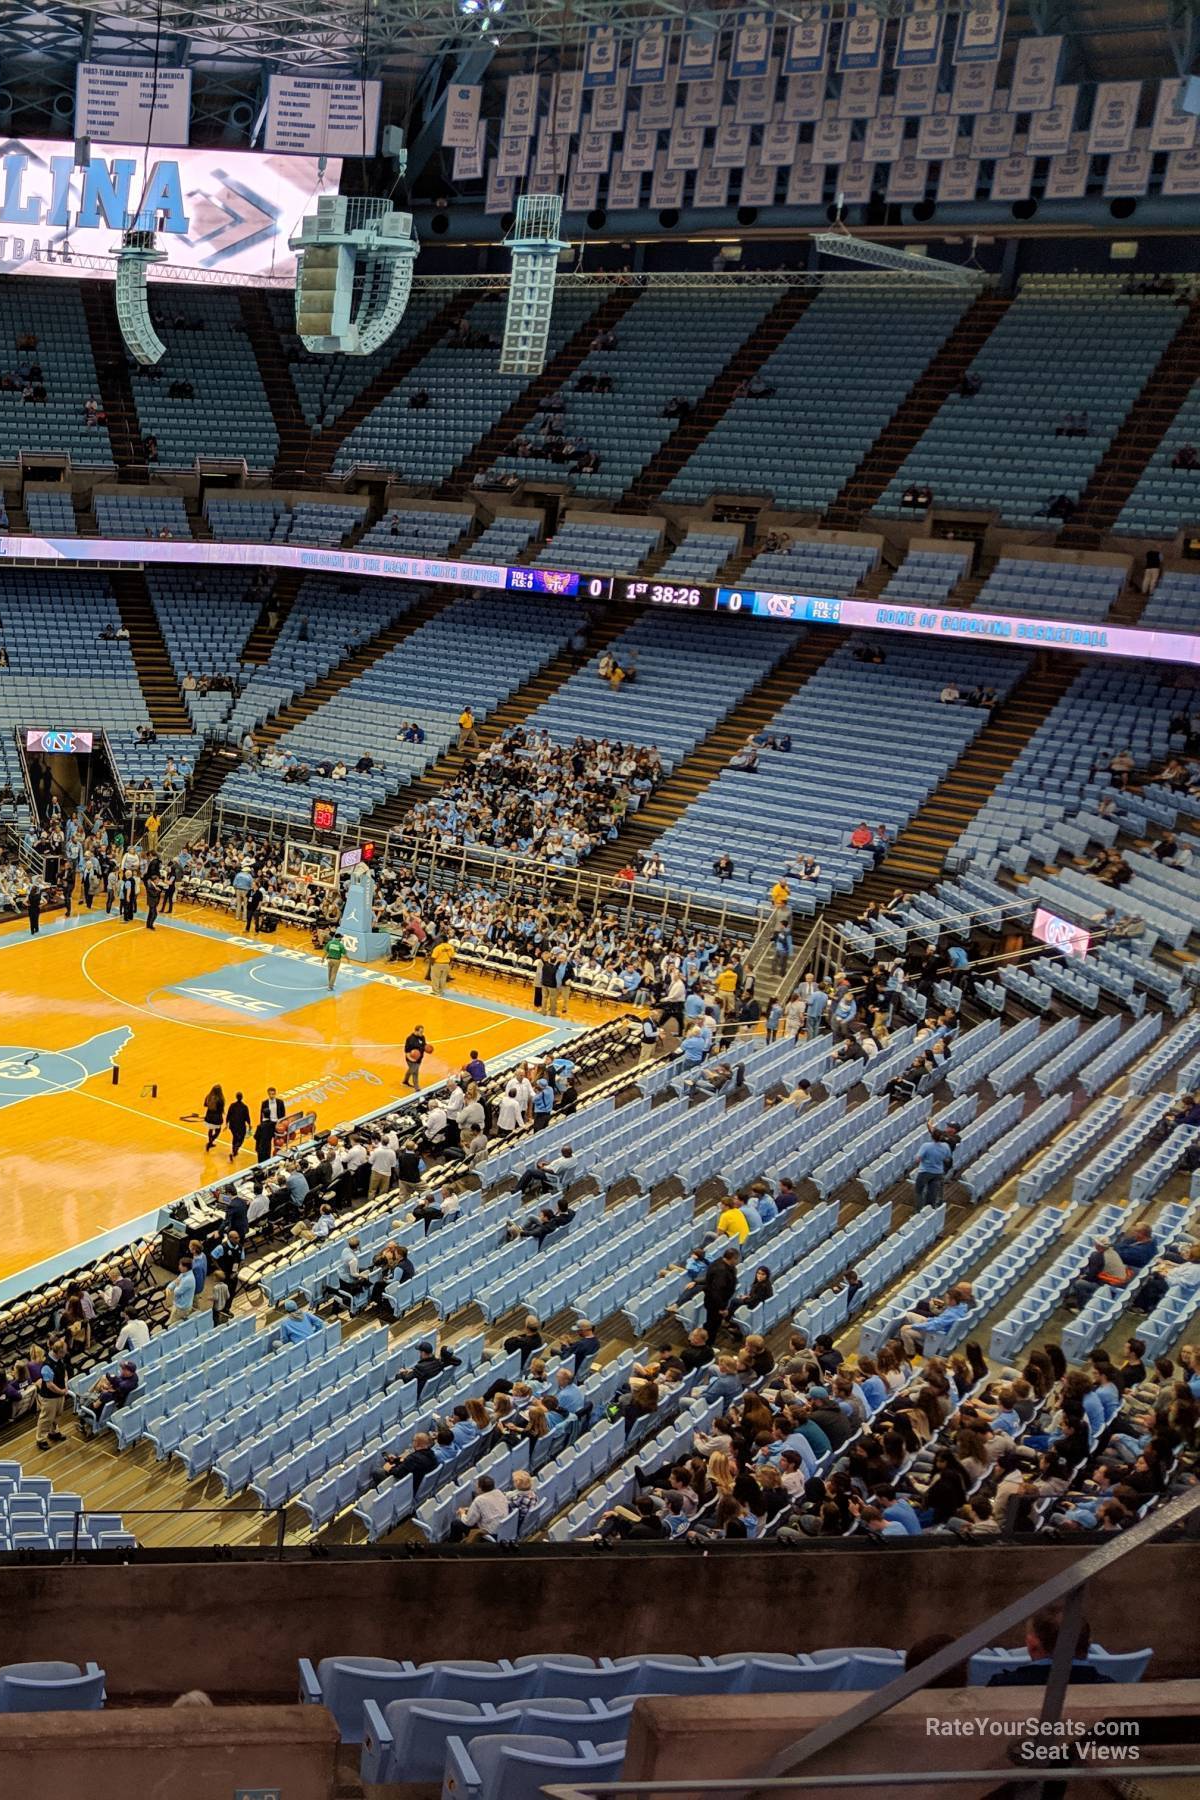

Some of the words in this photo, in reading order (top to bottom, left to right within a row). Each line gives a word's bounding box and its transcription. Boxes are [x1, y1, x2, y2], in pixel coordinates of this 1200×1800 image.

[115, 69, 143, 78] ACADEMIC
[349, 556, 360, 570] TO
[363, 557, 380, 571] THE
[424, 563, 458, 579] SMITH
[461, 567, 500, 584] CENTER
[511, 571, 528, 580] TOL:
[528, 573, 534, 581] 4
[511, 579, 527, 588] FLS:
[526, 580, 533, 589] 0
[590, 579, 602, 596] 0
[626, 583, 648, 599] 1ST
[651, 585, 700, 606] 38:26
[729, 592, 742, 611] 0
[813, 600, 832, 611] TOL:
[833, 602, 840, 611] 4
[812, 609, 832, 619] FLS:
[832, 611, 839, 620] 0
[876, 608, 916, 627] HOME
[919, 613, 937, 628] OF
[941, 615, 1012, 638] CAROLINA
[1016, 624, 1109, 648] BASKETBALL
